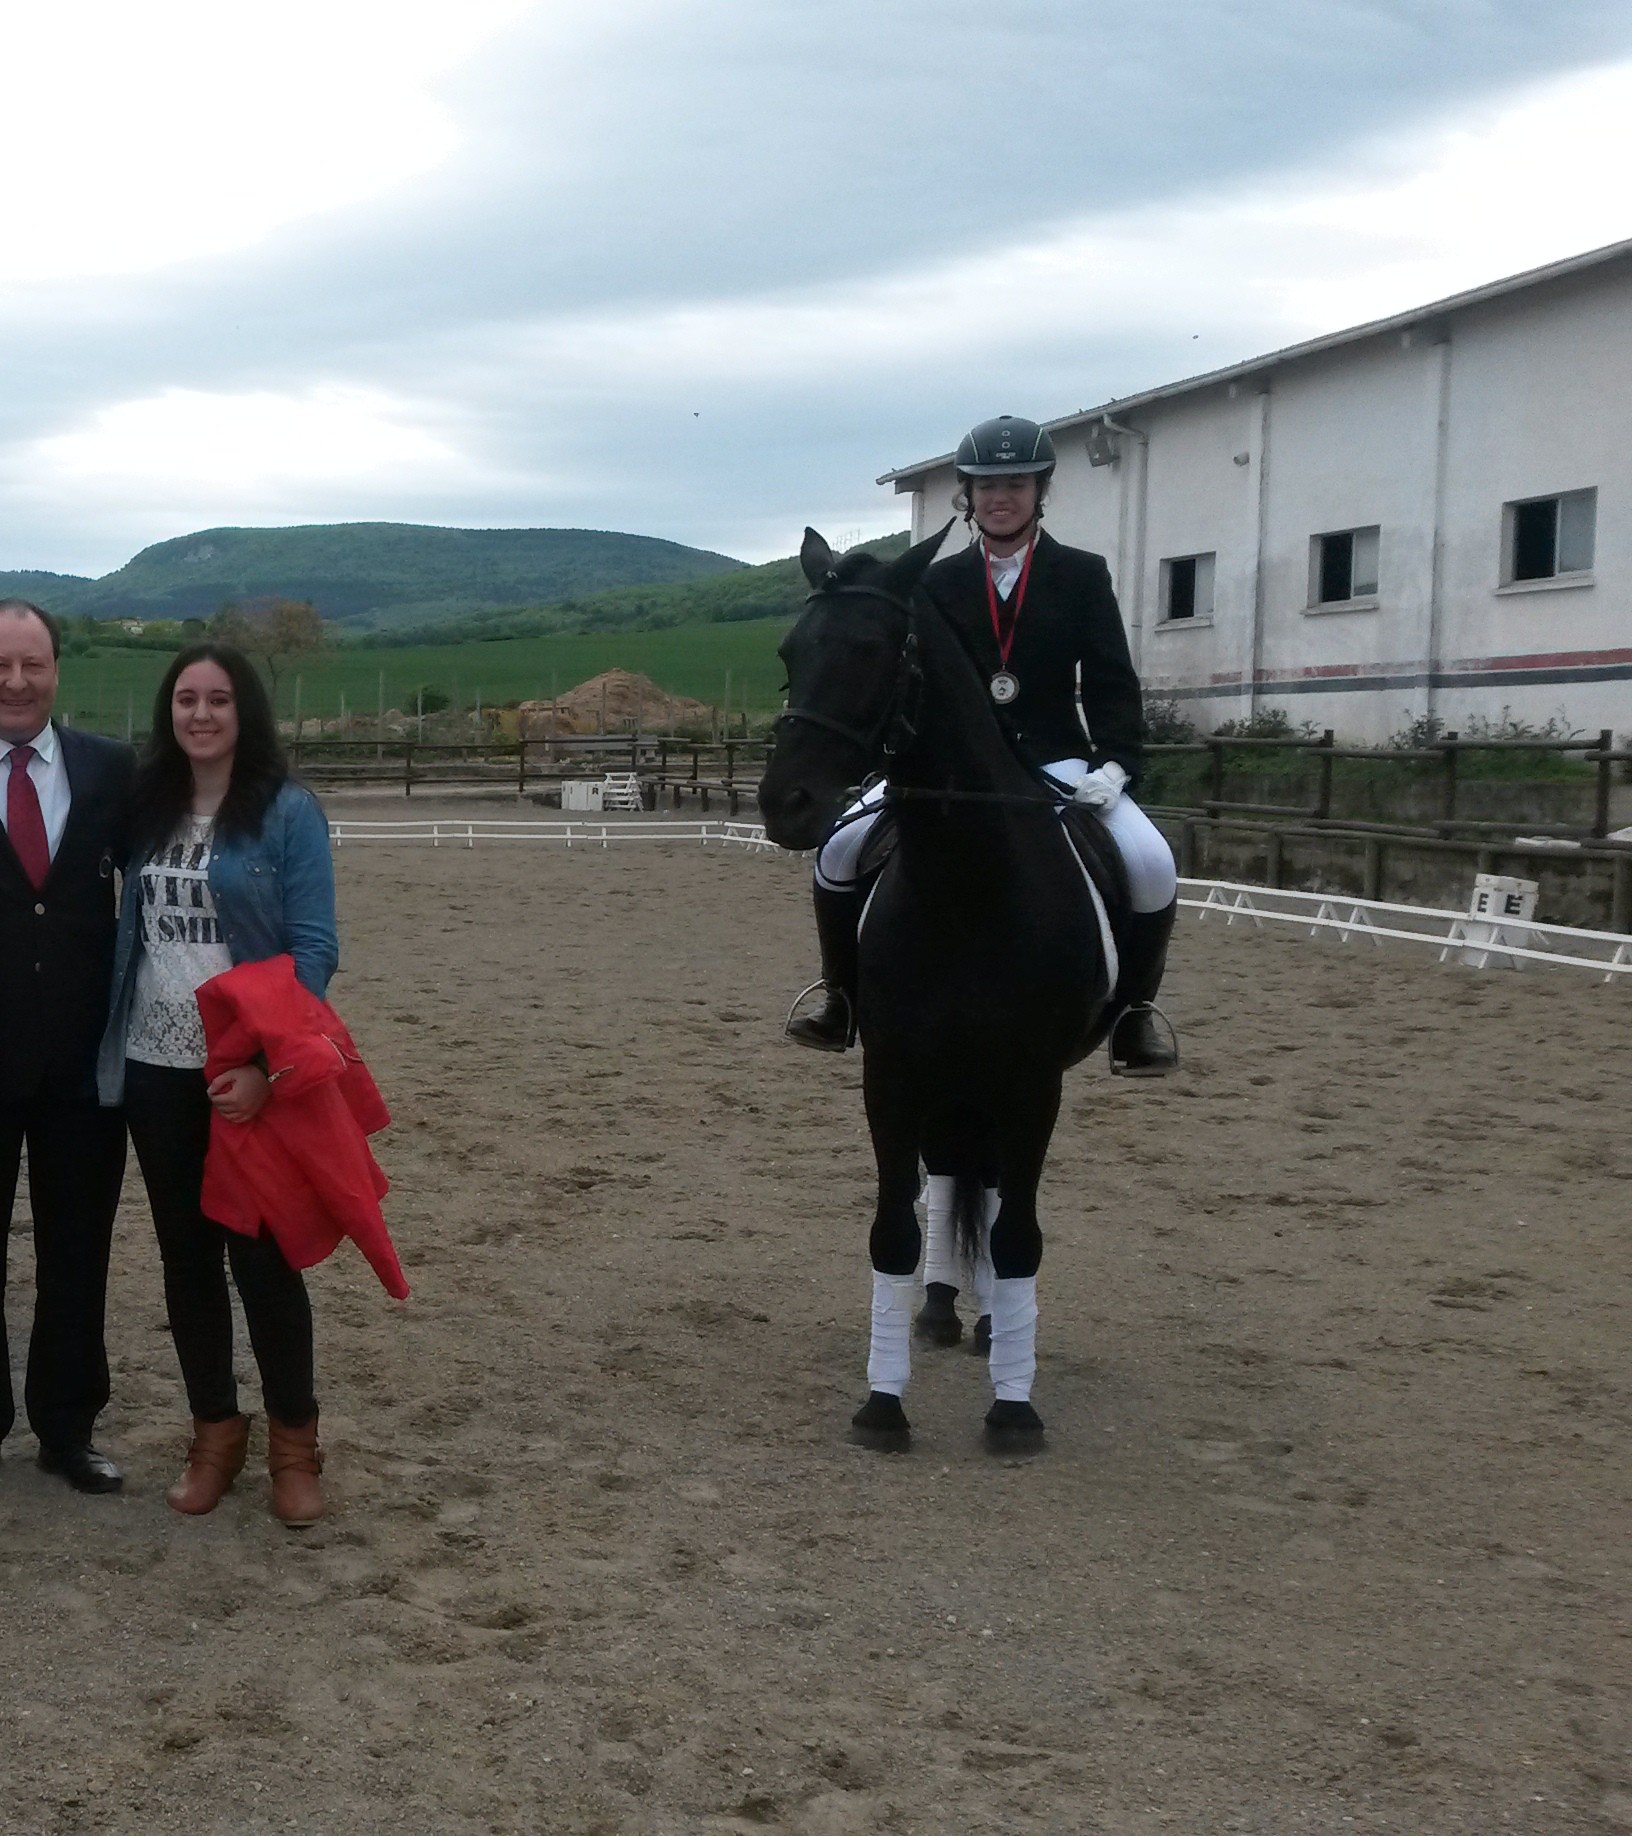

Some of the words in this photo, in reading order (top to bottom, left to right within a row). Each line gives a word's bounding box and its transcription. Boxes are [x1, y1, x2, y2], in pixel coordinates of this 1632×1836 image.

[1477, 892, 1489, 913] E
[1504, 893, 1523, 915] E
[157, 914, 225, 943] SMIL
